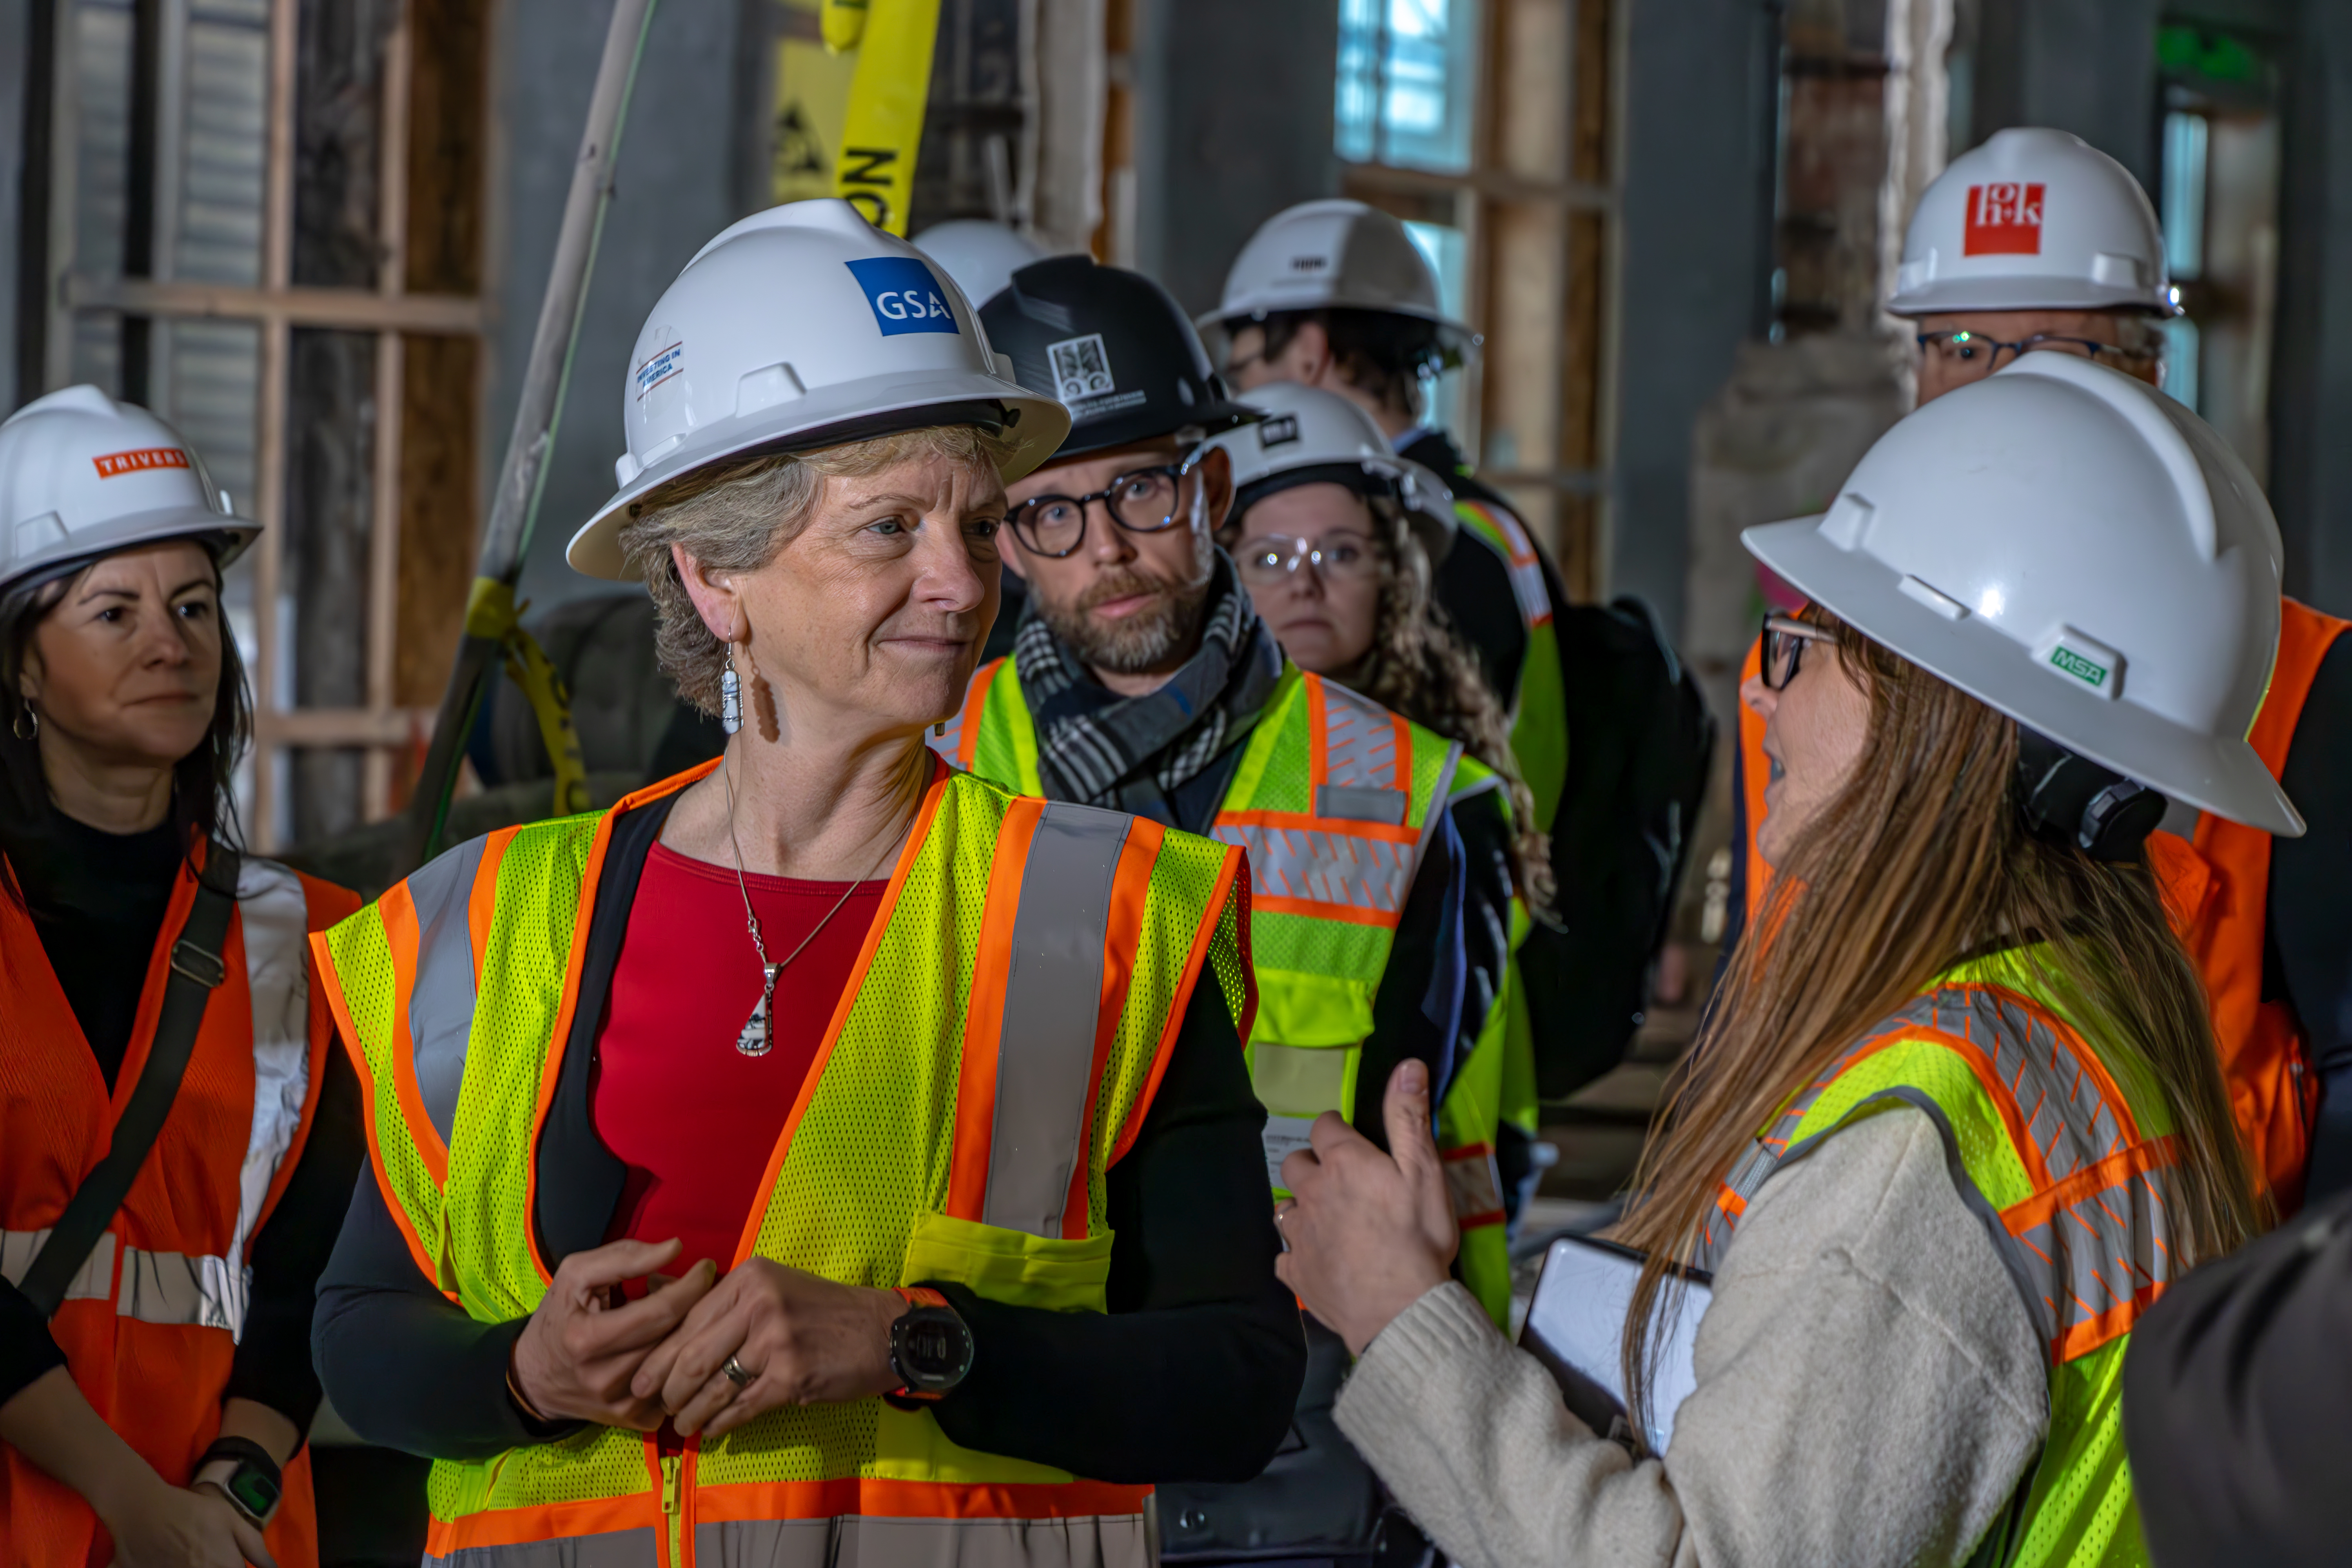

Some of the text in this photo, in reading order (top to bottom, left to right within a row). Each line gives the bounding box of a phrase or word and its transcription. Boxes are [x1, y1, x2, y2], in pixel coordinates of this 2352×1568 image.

[876, 290, 951, 320] GSA
[637, 348, 681, 384] INVESTING IN
[643, 363, 673, 389] AMERICA
[99, 451, 185, 474] TRIVERS
[2054, 650, 2101, 685] MSA
